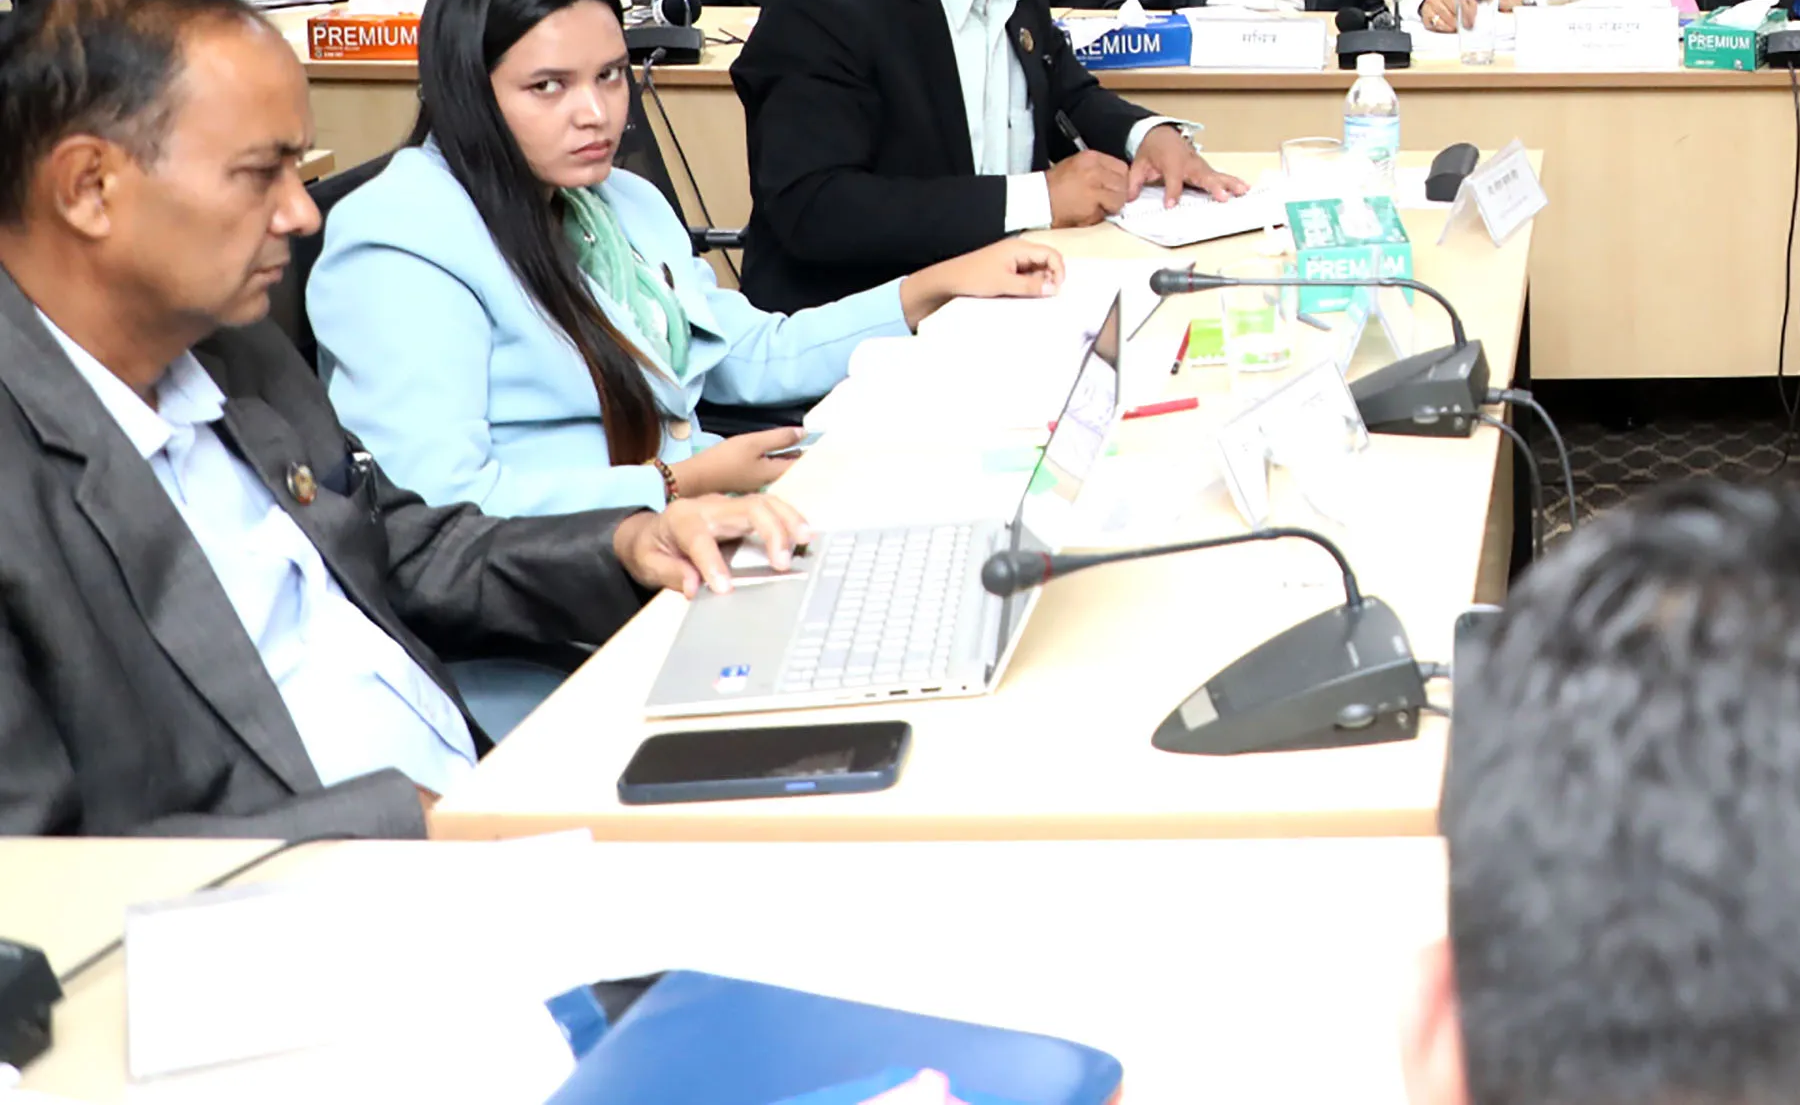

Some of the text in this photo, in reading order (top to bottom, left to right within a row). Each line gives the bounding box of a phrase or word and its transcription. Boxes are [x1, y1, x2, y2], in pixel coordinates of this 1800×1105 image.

[313, 25, 418, 46] PREMIUM
[1079, 33, 1161, 54] EMIUM
[1688, 34, 1751, 50] PREMIUM
[1304, 256, 1407, 281] PREMM
